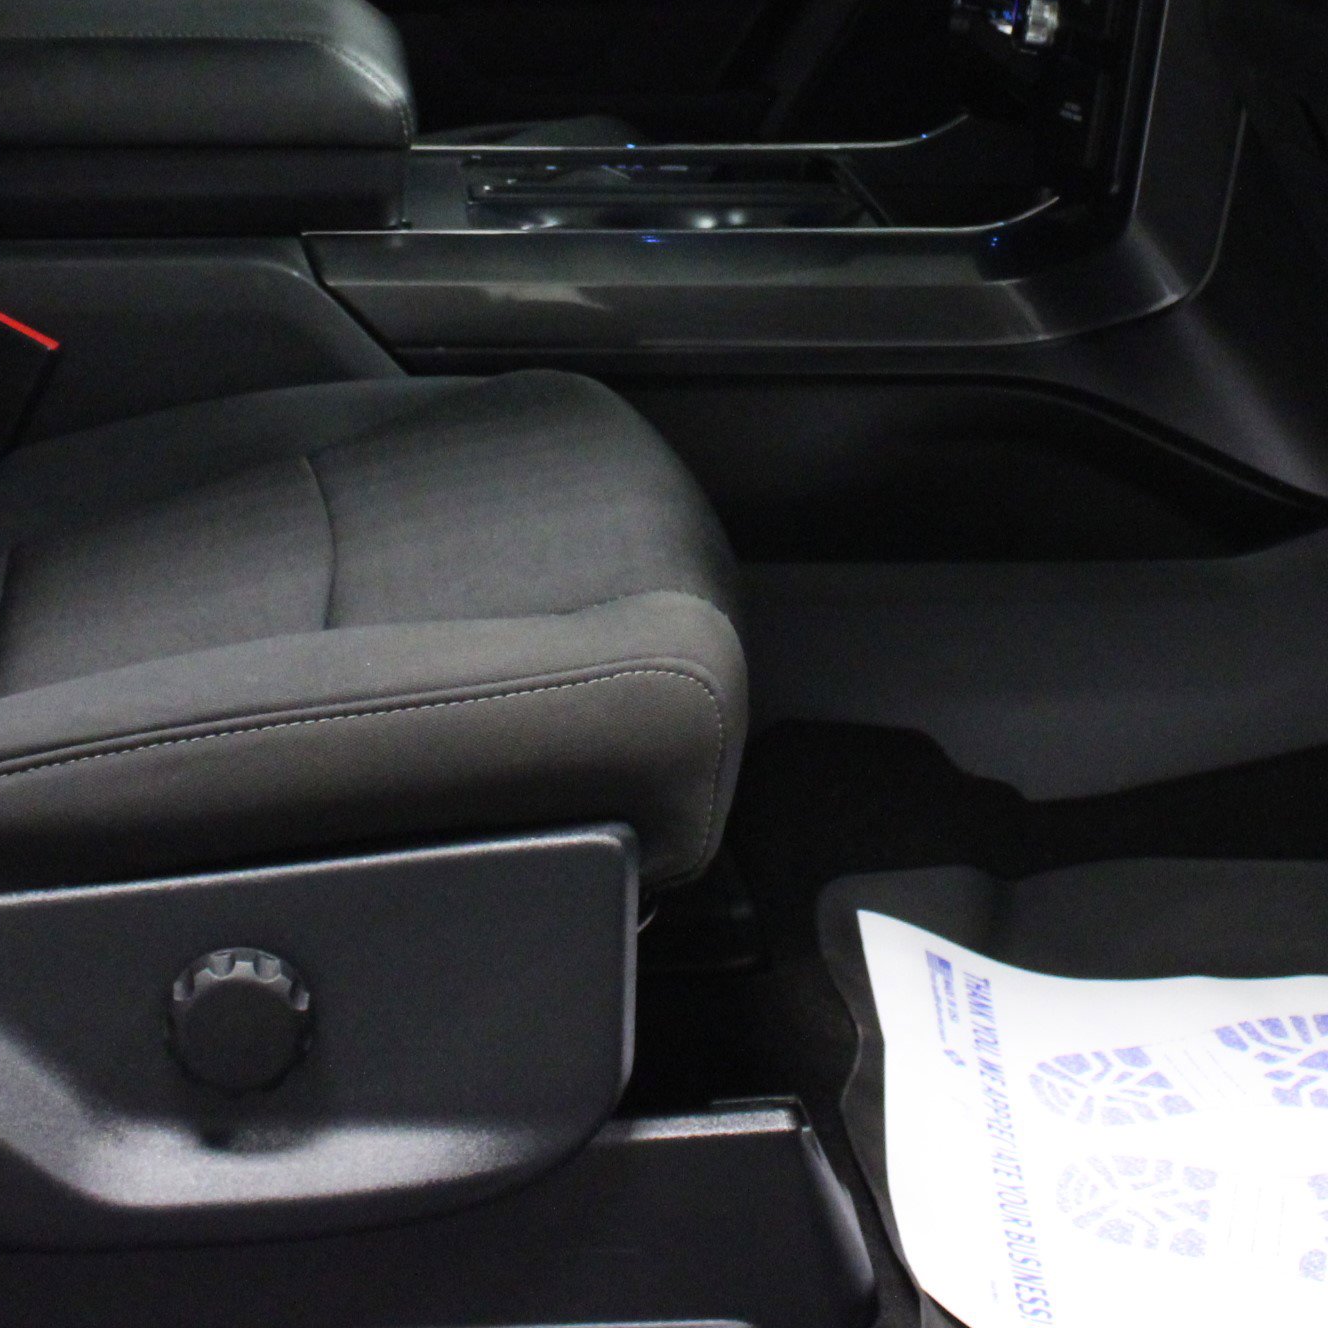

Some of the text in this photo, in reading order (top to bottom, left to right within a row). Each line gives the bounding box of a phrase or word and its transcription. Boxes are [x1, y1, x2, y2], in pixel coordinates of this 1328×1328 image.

[963, 971, 996, 1024] THANK
[995, 1181, 1033, 1229] YOUR
[1004, 1229, 1054, 1325] BUSINESS!
